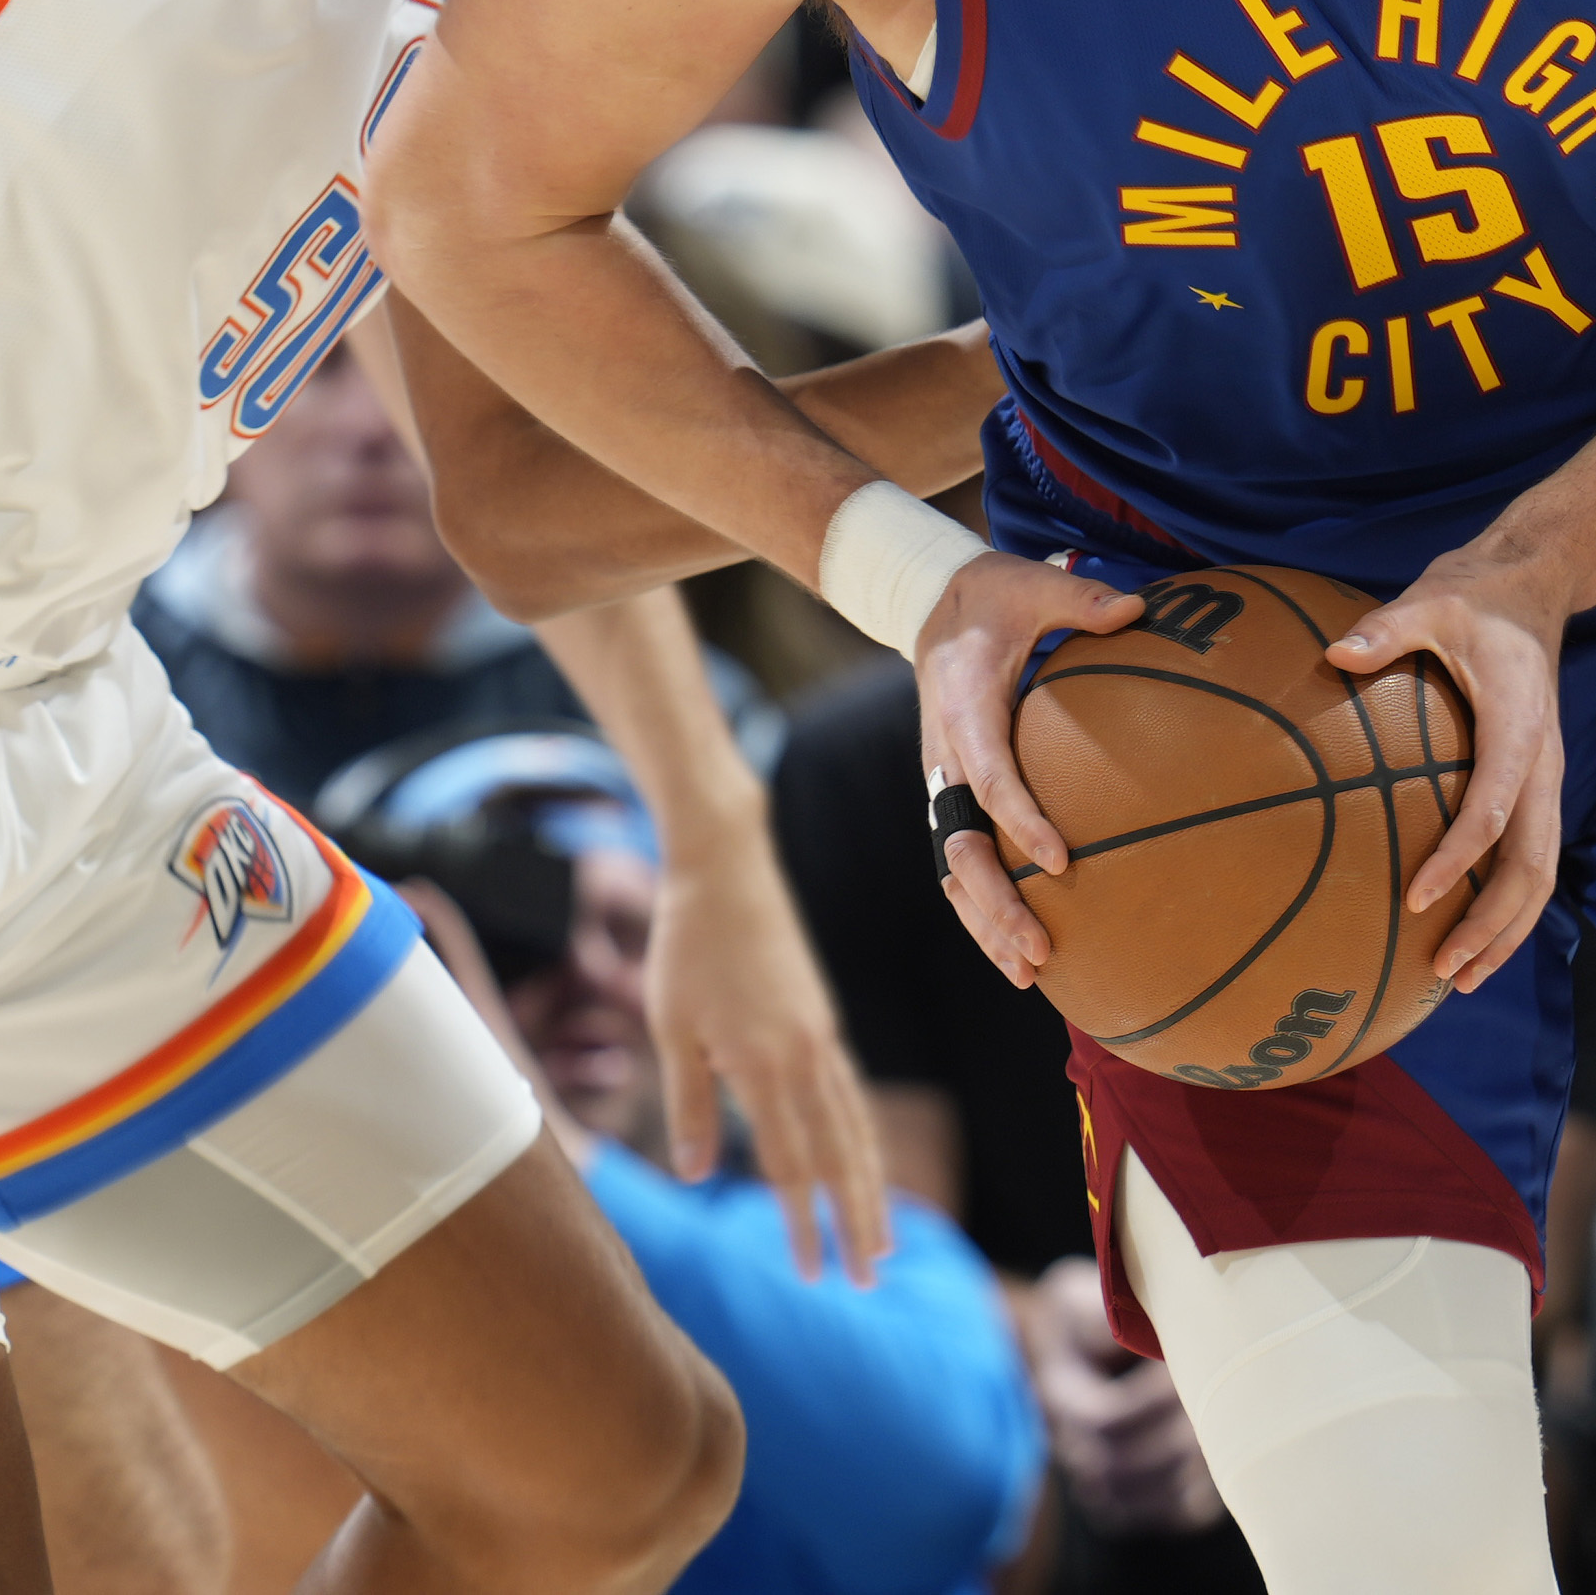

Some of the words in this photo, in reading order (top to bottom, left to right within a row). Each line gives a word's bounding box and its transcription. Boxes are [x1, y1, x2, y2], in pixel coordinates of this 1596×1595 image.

[1300, 114, 1527, 291] 15
[199, 174, 387, 439] 50
[1305, 246, 1595, 414] CITY
